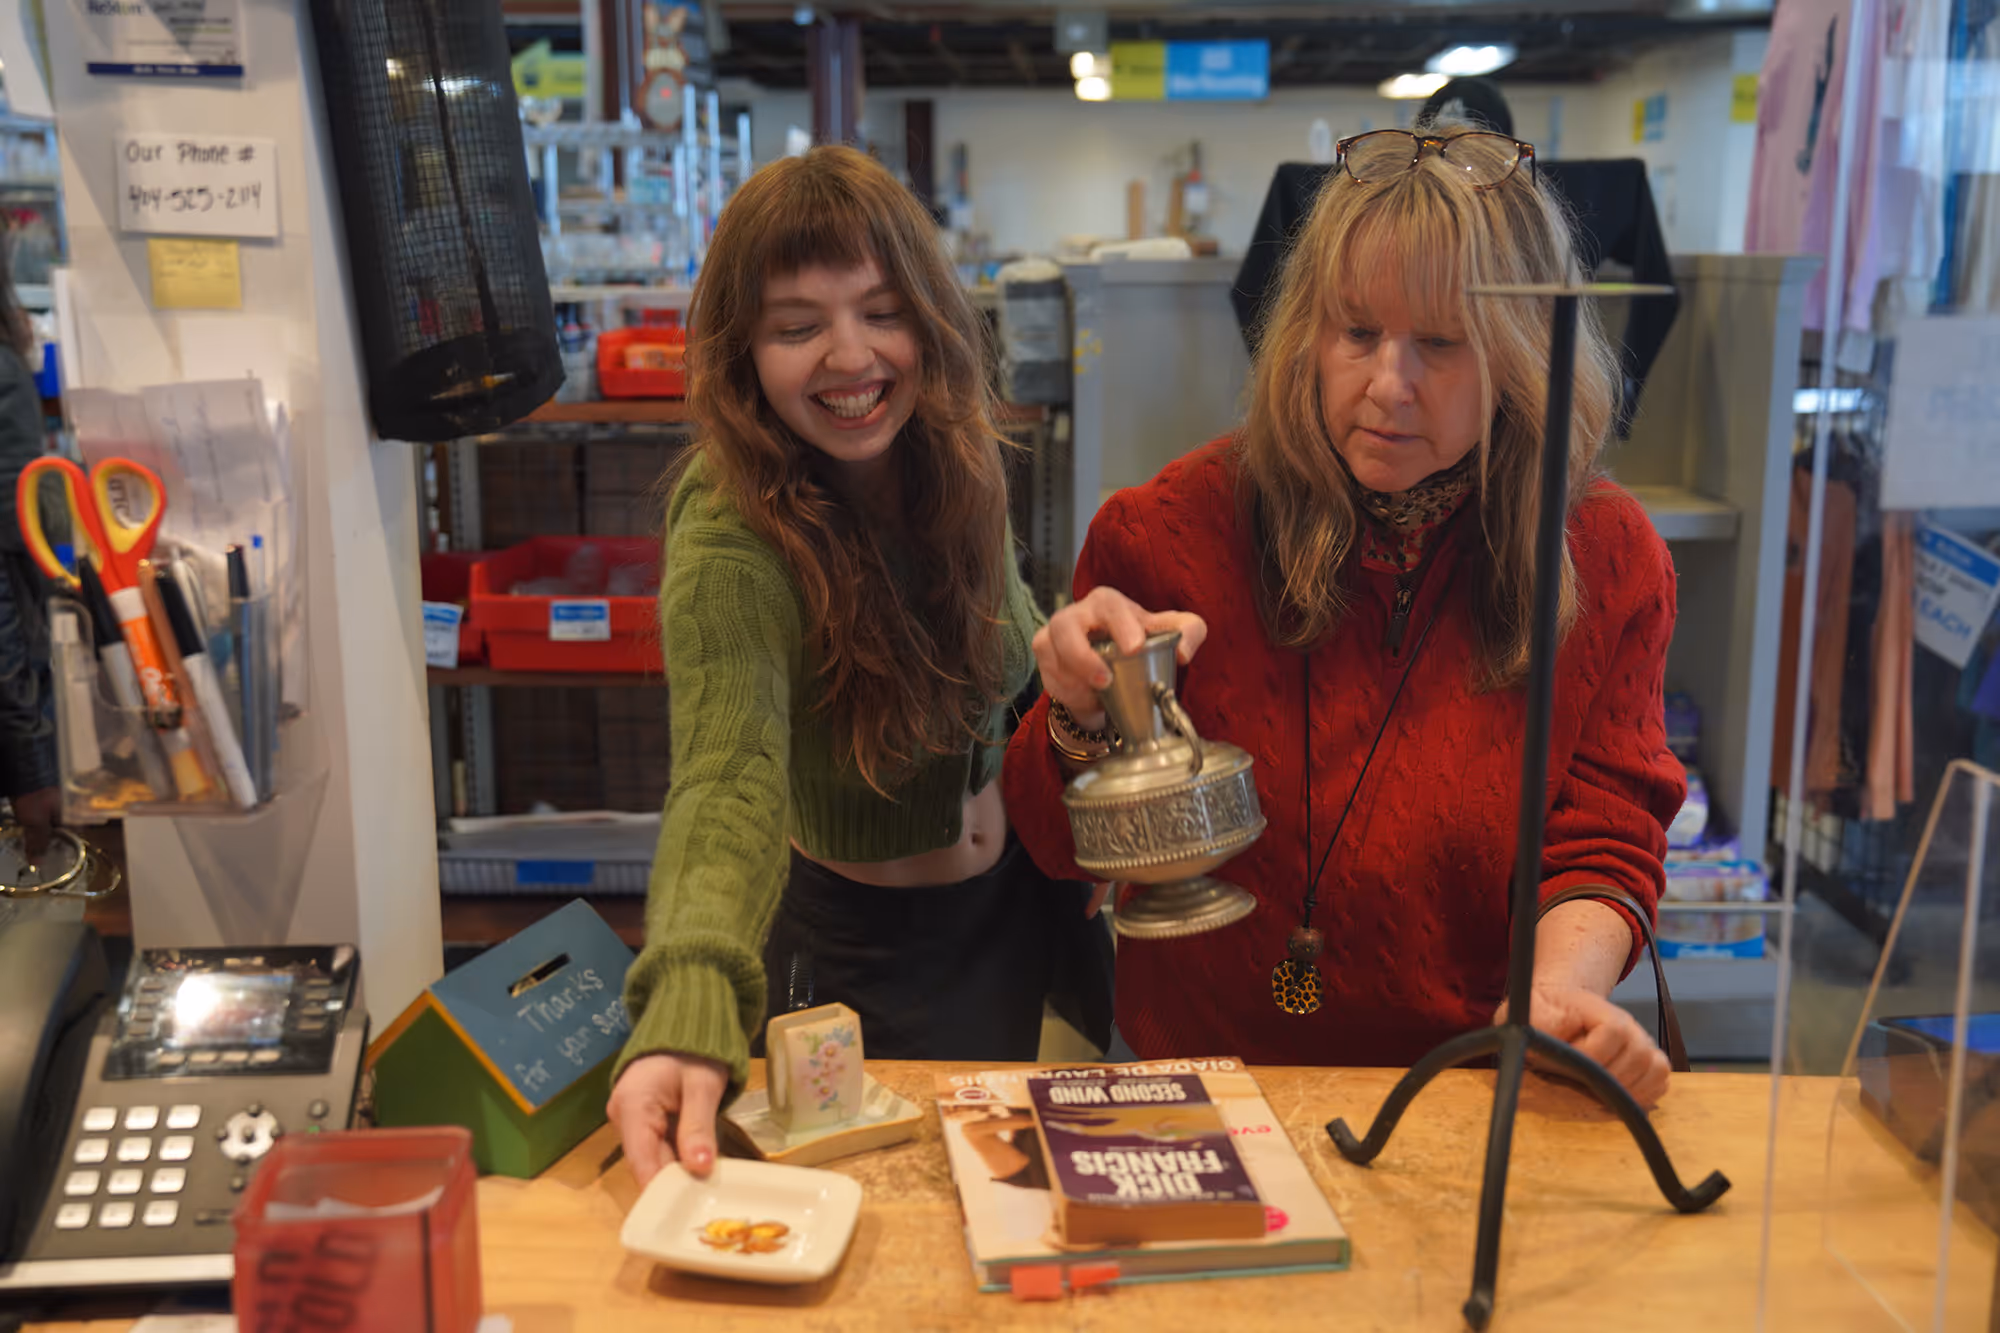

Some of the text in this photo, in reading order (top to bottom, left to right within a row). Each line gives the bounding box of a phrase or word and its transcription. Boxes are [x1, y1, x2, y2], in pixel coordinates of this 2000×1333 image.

[126, 140, 256, 164] Our Phone #
[517, 968, 604, 1033] Thanks
[514, 1058, 551, 1093] for
[1113, 1065, 1147, 1077] DE
[1155, 1059, 1236, 1073] GIADA
[1049, 1082, 1187, 1105] SECOND WIND
[1070, 1150, 1225, 1176] FRANCIS
[1108, 1172, 1203, 1200] DICK
